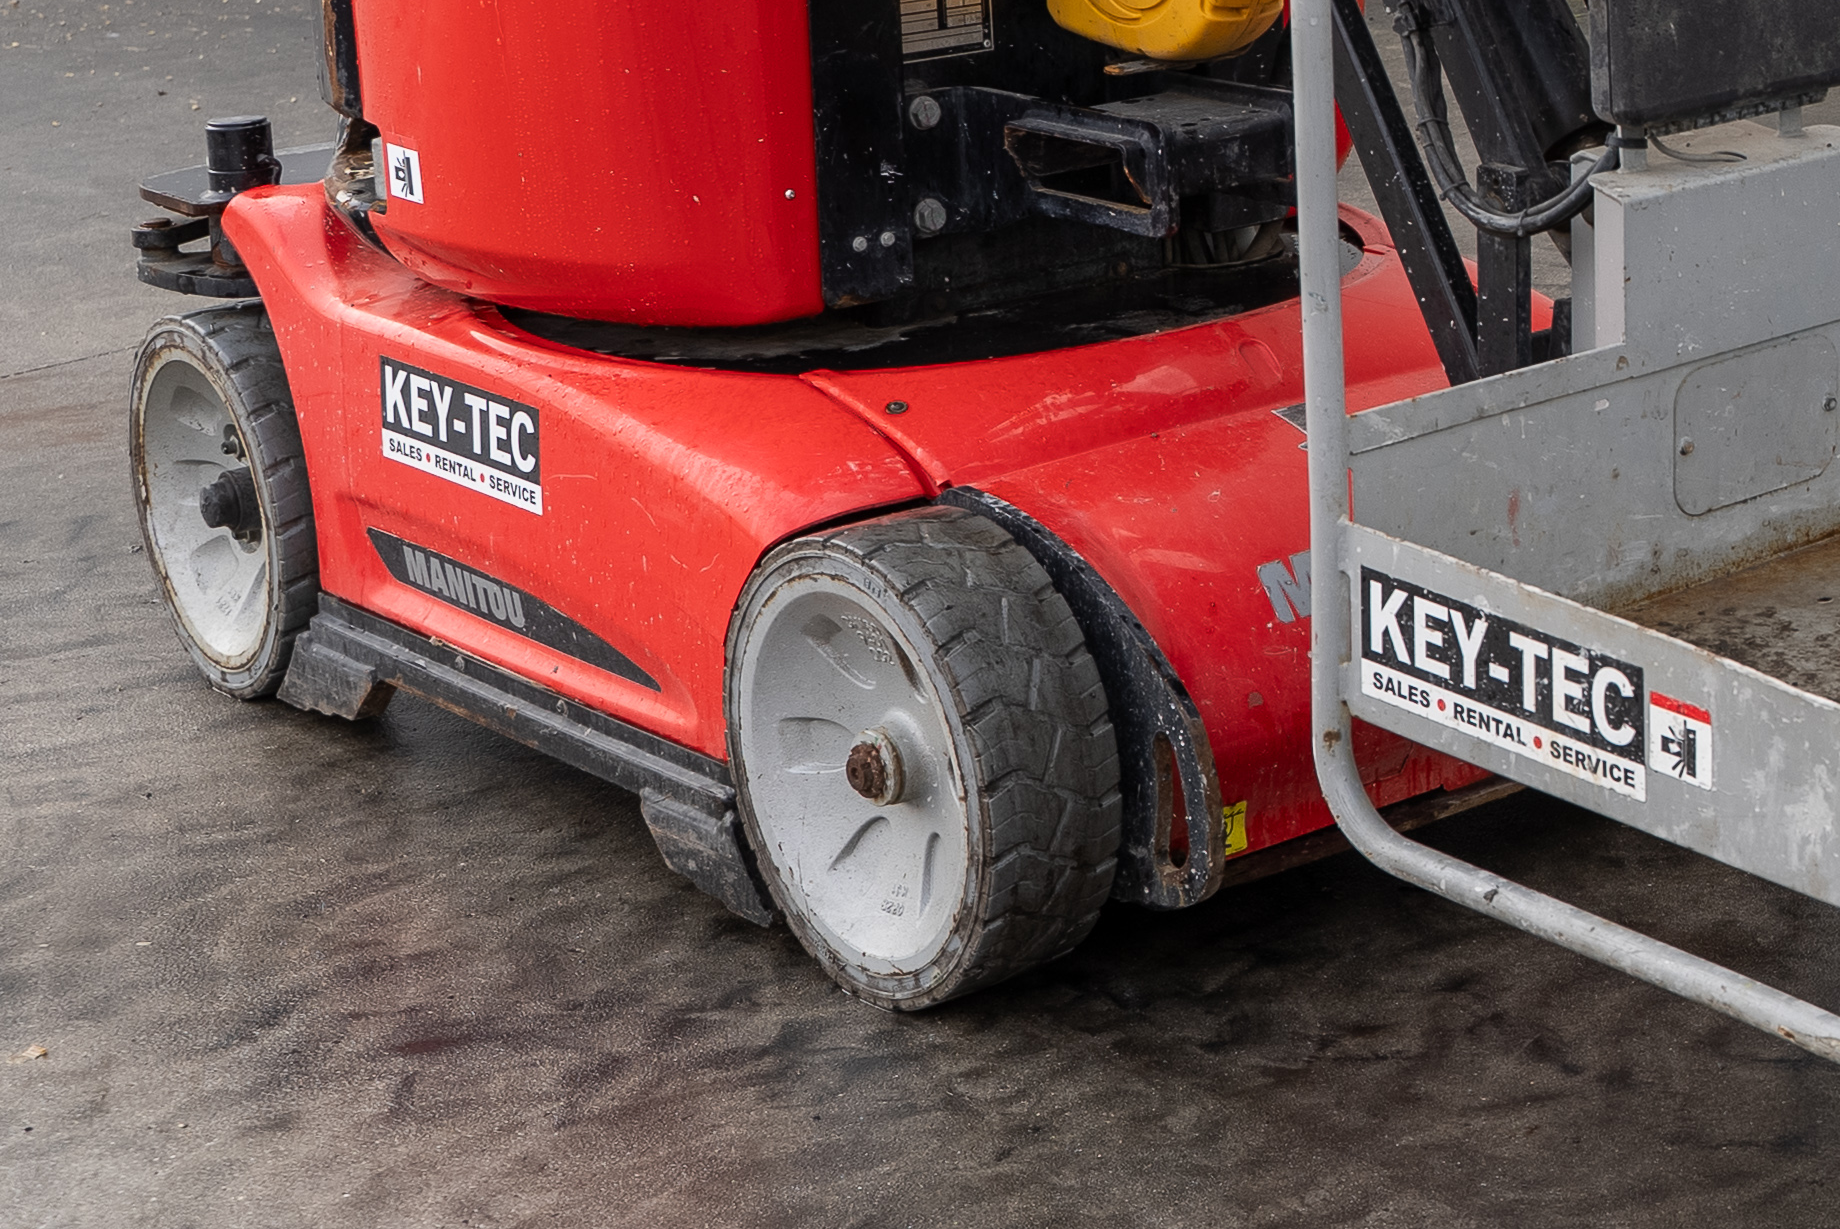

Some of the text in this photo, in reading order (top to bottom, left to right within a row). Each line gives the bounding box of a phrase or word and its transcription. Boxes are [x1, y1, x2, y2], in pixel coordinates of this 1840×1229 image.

[385, 365, 536, 473] KEY-TEC
[389, 437, 537, 506] SALES RENTAL SERVICE
[403, 545, 526, 628] MANITOU
[1369, 579, 1637, 748] KEY-TEC
[1372, 671, 1636, 789] SALES RENTAL SERVICE
